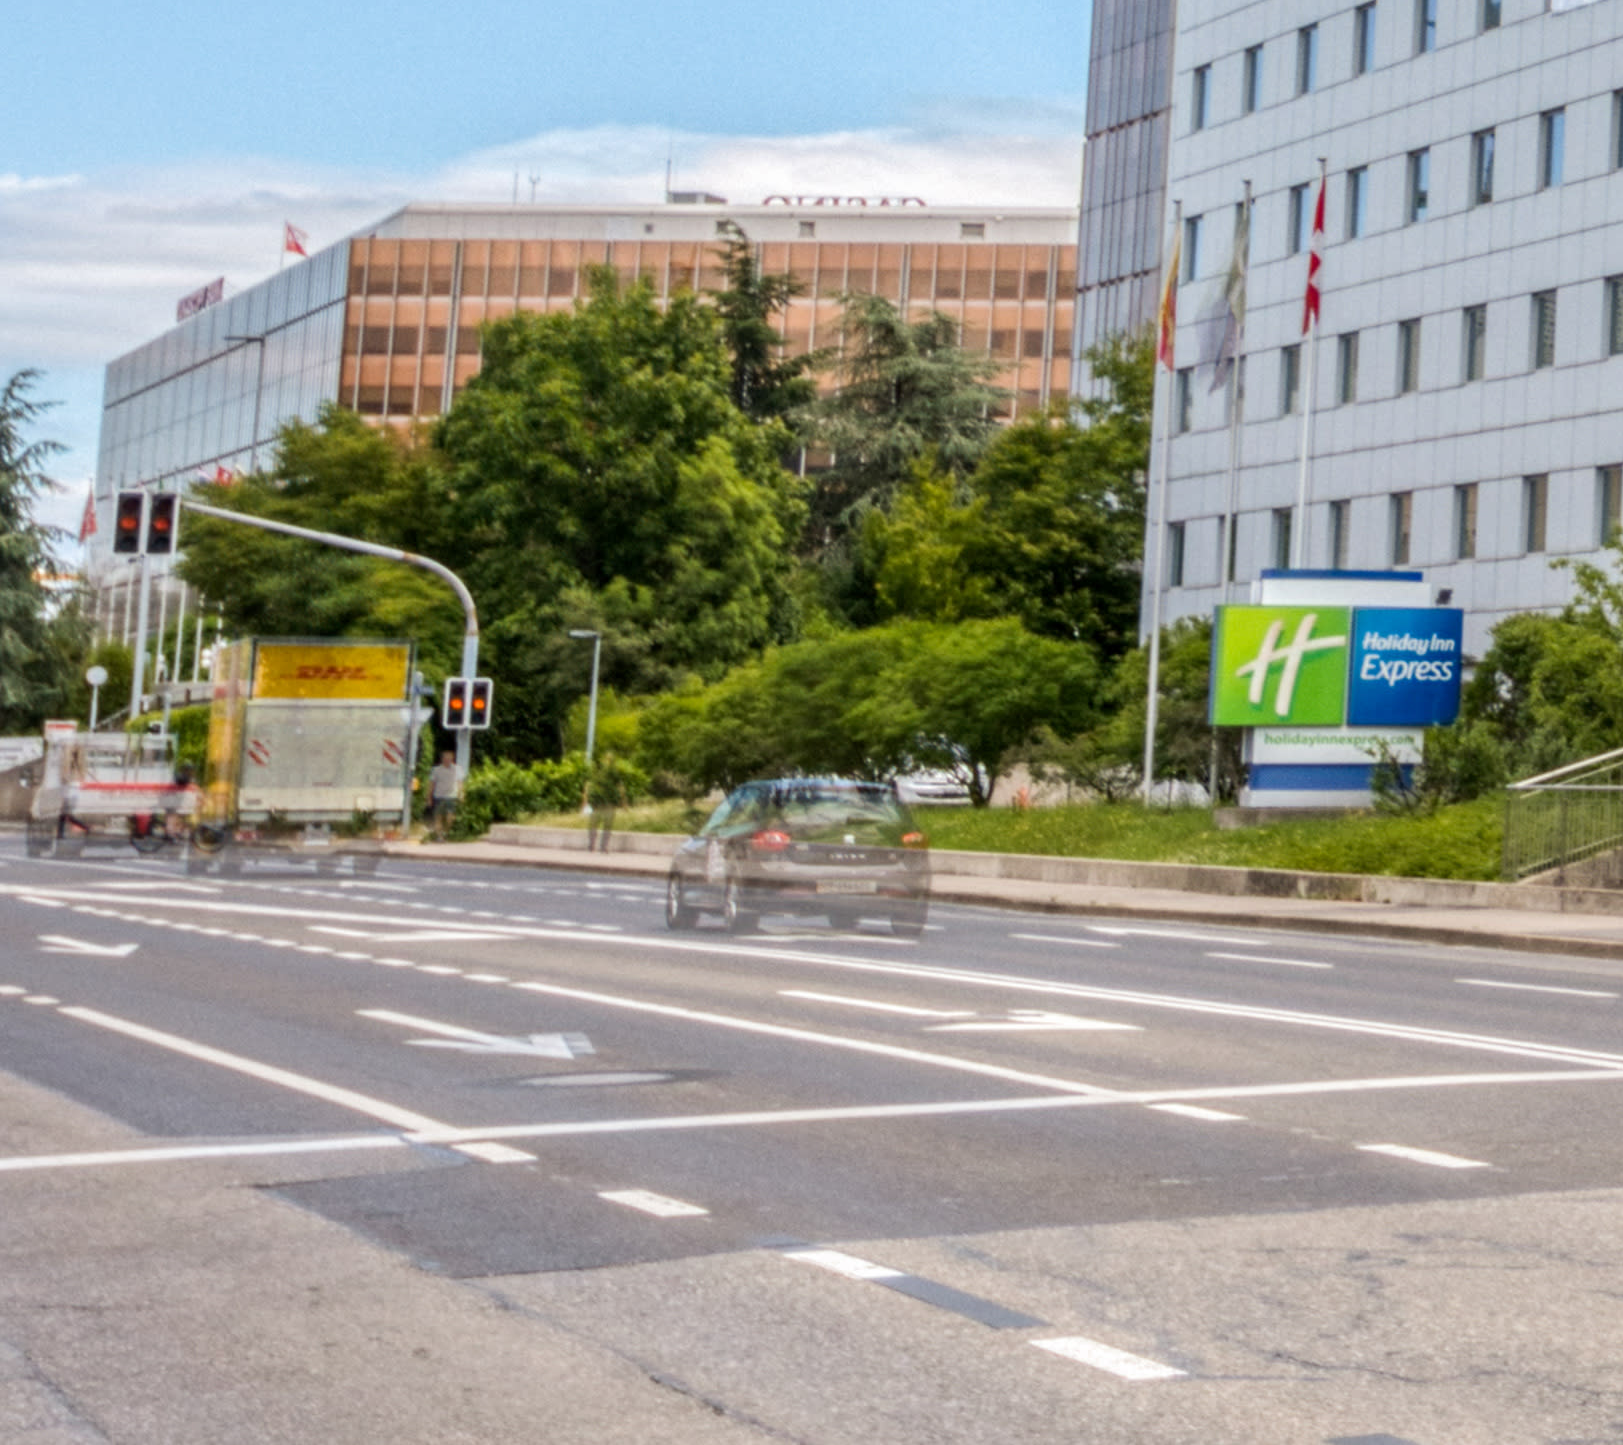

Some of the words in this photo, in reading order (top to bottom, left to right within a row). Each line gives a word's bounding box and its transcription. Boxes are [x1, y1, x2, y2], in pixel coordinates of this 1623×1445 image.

[1363, 631, 1429, 655] Holiday
[1430, 635, 1455, 651] Inn
[297, 665, 367, 680] DHL
[1360, 654, 1453, 686] Express
